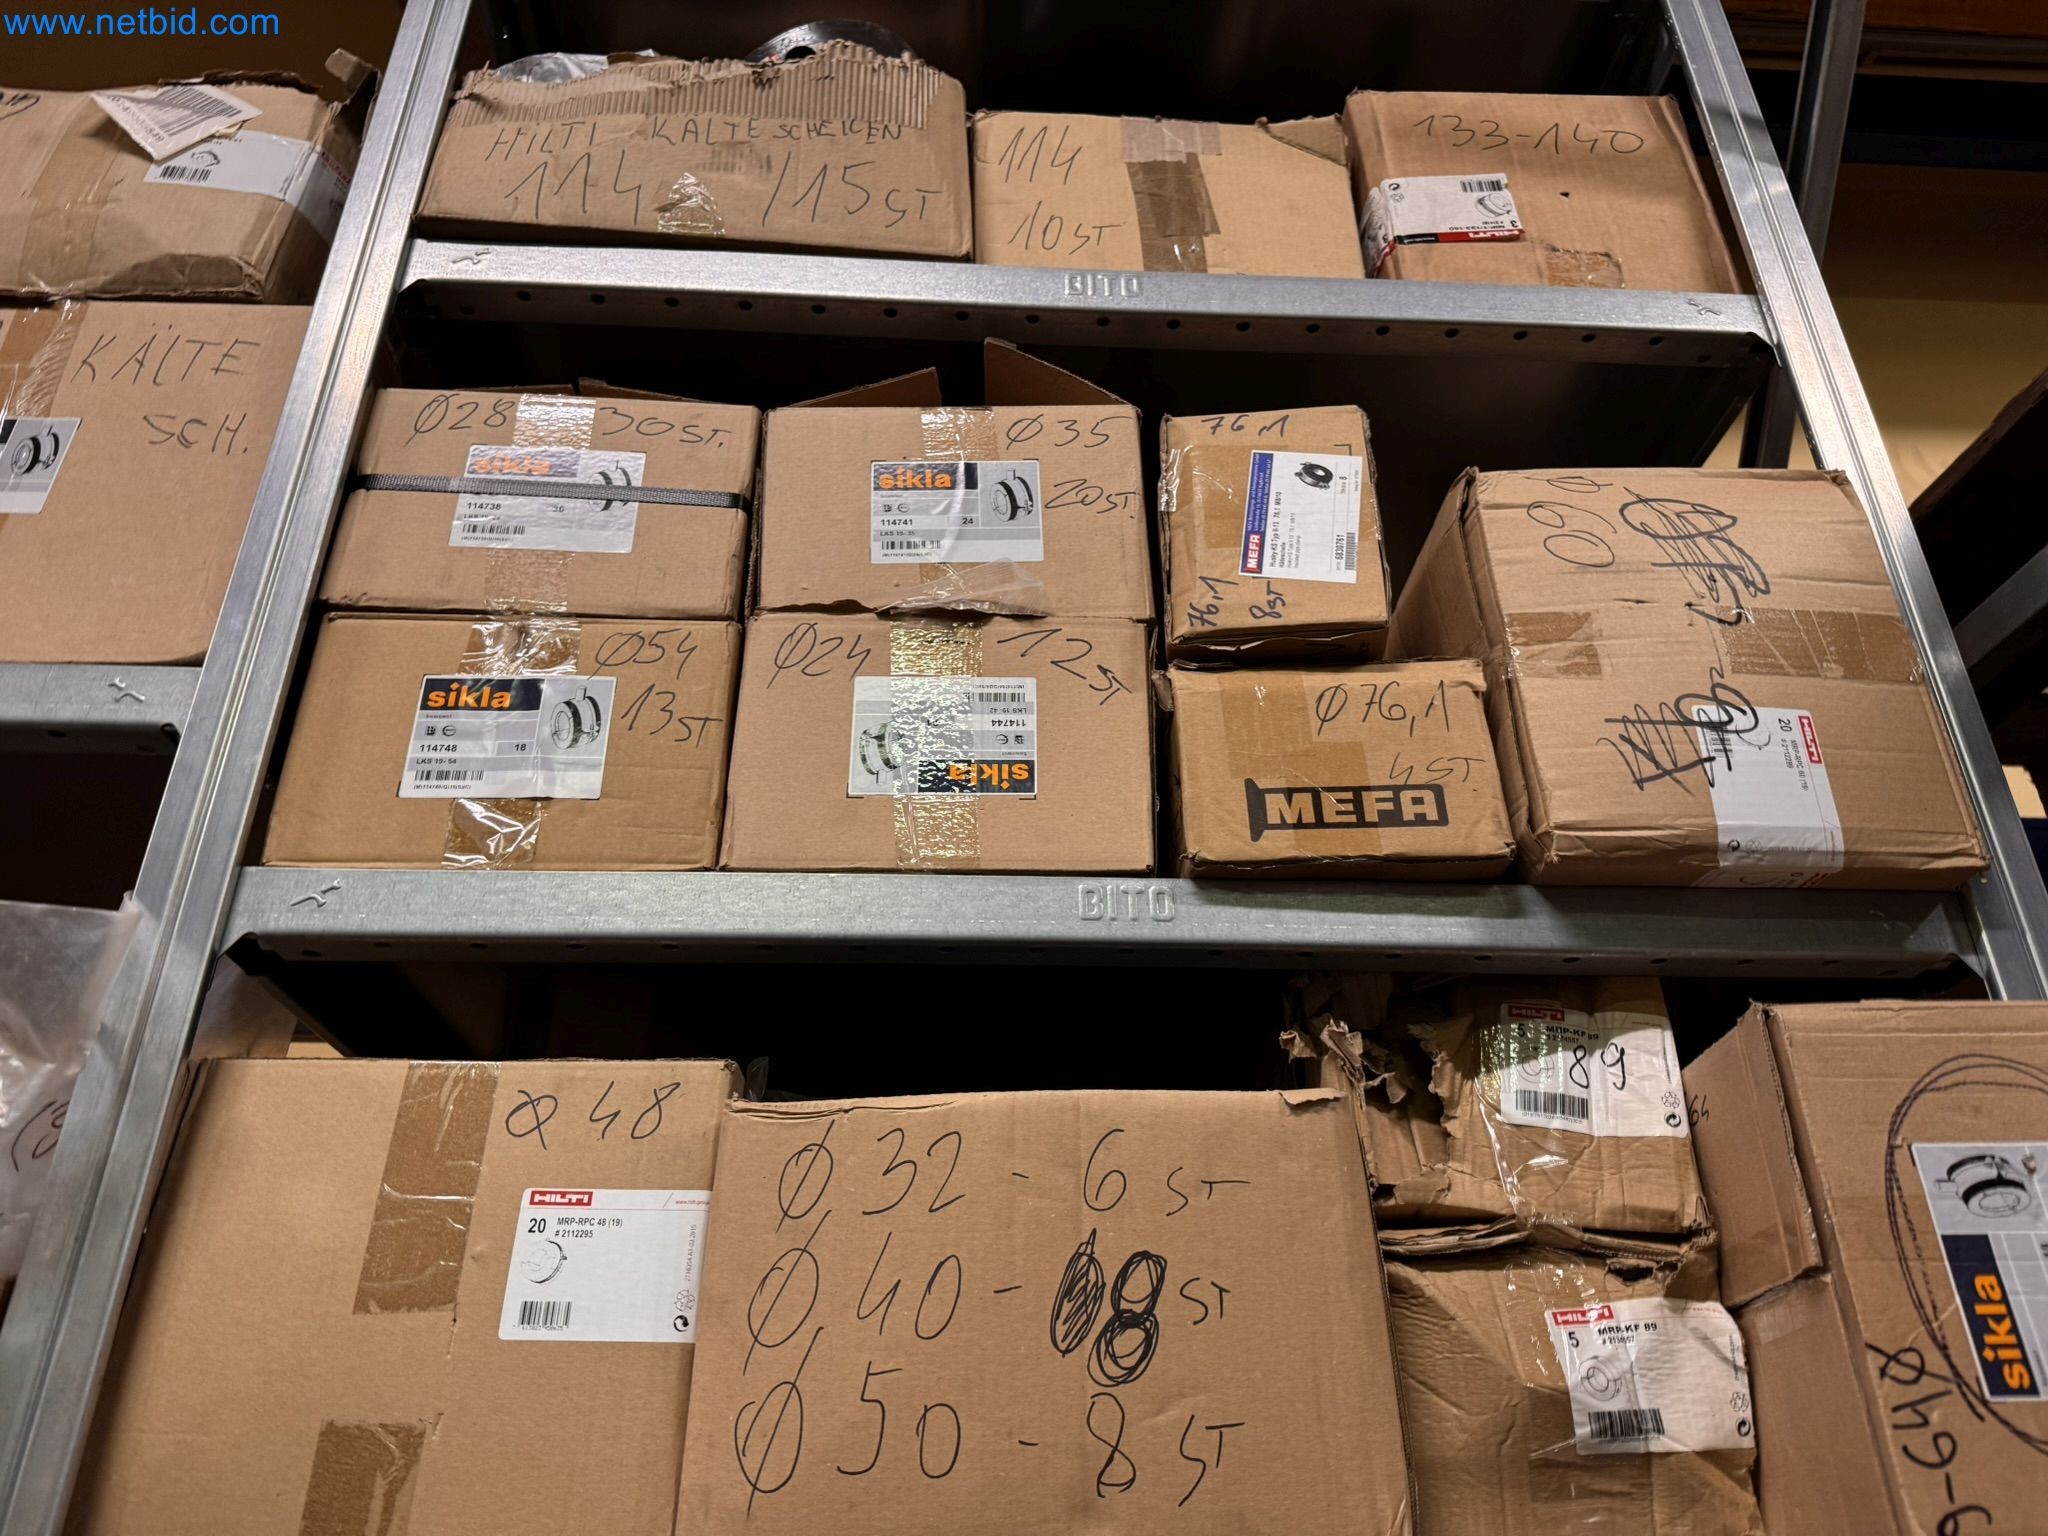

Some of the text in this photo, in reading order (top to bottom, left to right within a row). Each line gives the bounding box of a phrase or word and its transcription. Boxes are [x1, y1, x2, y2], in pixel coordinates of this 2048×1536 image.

[485, 121, 598, 161] HILTI
[1412, 114, 1645, 155] 133-140
[997, 124, 1083, 186] 114
[503, 150, 642, 225] 114
[1509, 219, 1519, 229] 3
[1063, 272, 1142, 299] BITO
[70, 322, 261, 387] KÄLTE
[142, 413, 250, 456] SCH.
[878, 466, 952, 491] sikla
[879, 518, 915, 526] 114741
[961, 517, 974, 526] 24
[1246, 534, 1261, 569] MEFA
[426, 682, 513, 710] sikla
[990, 717, 1028, 728] 114744
[1777, 717, 1793, 733] 20
[418, 743, 459, 753] 114748
[513, 742, 528, 752] 18
[1800, 717, 1820, 762] HILTI
[415, 757, 433, 765] LKS
[947, 762, 1031, 791] sikla
[1264, 789, 1440, 825] MEFA
[1078, 884, 1175, 922] BITO
[1516, 1023, 1527, 1038] 5
[1569, 1042, 1627, 1091] 89
[588, 1080, 682, 1140] 48
[861, 1127, 967, 1216] 32
[1083, 1128, 1128, 1212] 6
[533, 1193, 591, 1204] HILTI
[527, 1218, 547, 1234] 20
[556, 1217, 623, 1229] MRP-RPC 48 (19)
[561, 1229, 595, 1239] 2112295
[855, 1231, 963, 1341] 40
[1568, 1331, 1580, 1349] 5
[1597, 1322, 1658, 1337] MRP-KF 89
[1974, 1273, 2032, 1391] sikla
[836, 1360, 962, 1480] 50
[1085, 1391, 1138, 1499] 8
